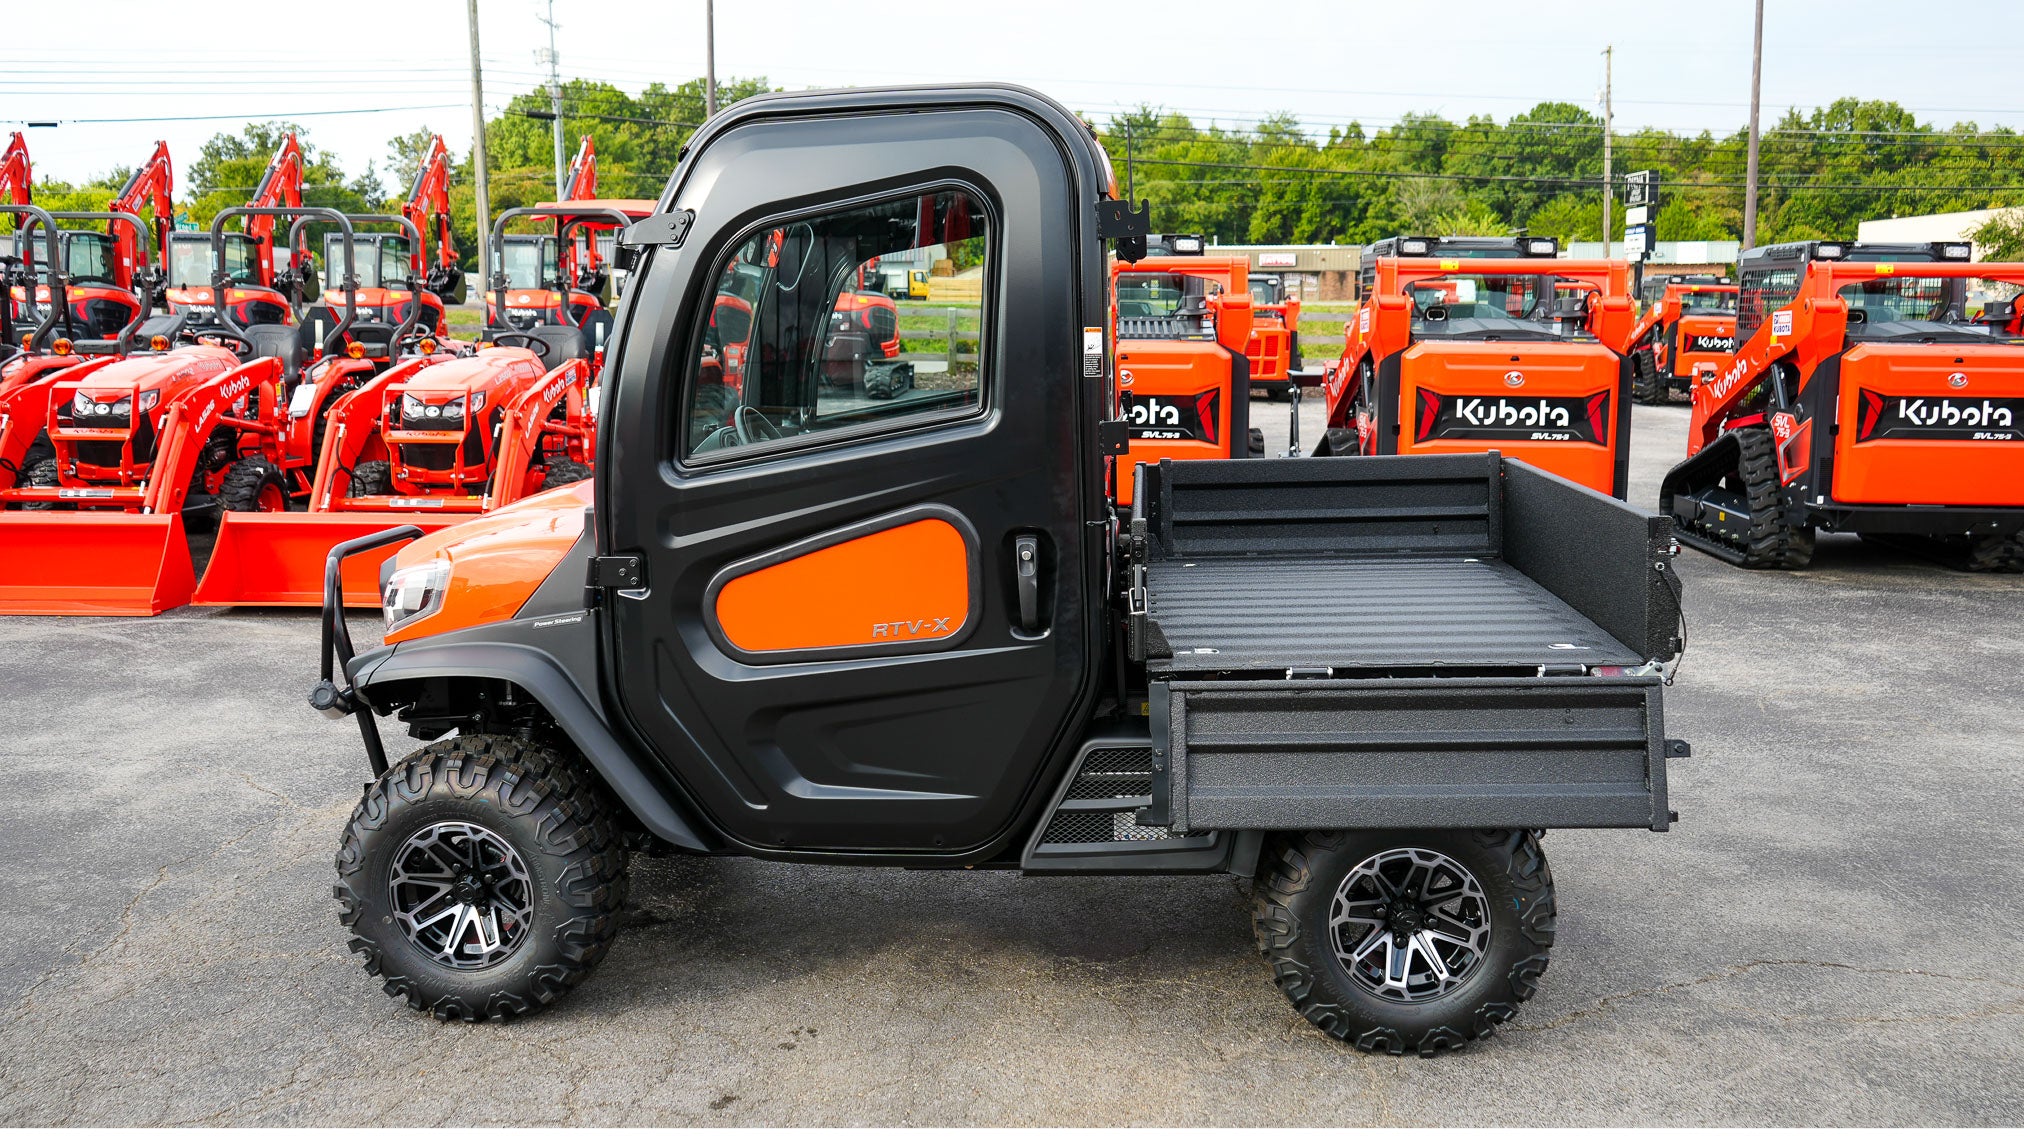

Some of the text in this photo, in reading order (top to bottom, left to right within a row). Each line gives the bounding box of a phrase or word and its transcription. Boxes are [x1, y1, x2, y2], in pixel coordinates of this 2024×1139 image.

[1698, 335, 1735, 348] Kubot
[220, 375, 250, 399] Kubota
[543, 377, 565, 403] Kubota
[1713, 359, 1748, 399] Kubota
[1456, 398, 1569, 427] Kubota
[1774, 415, 1790, 428] SVL
[1898, 399, 2012, 427] Kubota
[554, 616, 582, 624] Steering
[872, 617, 950, 638] RTV-X
